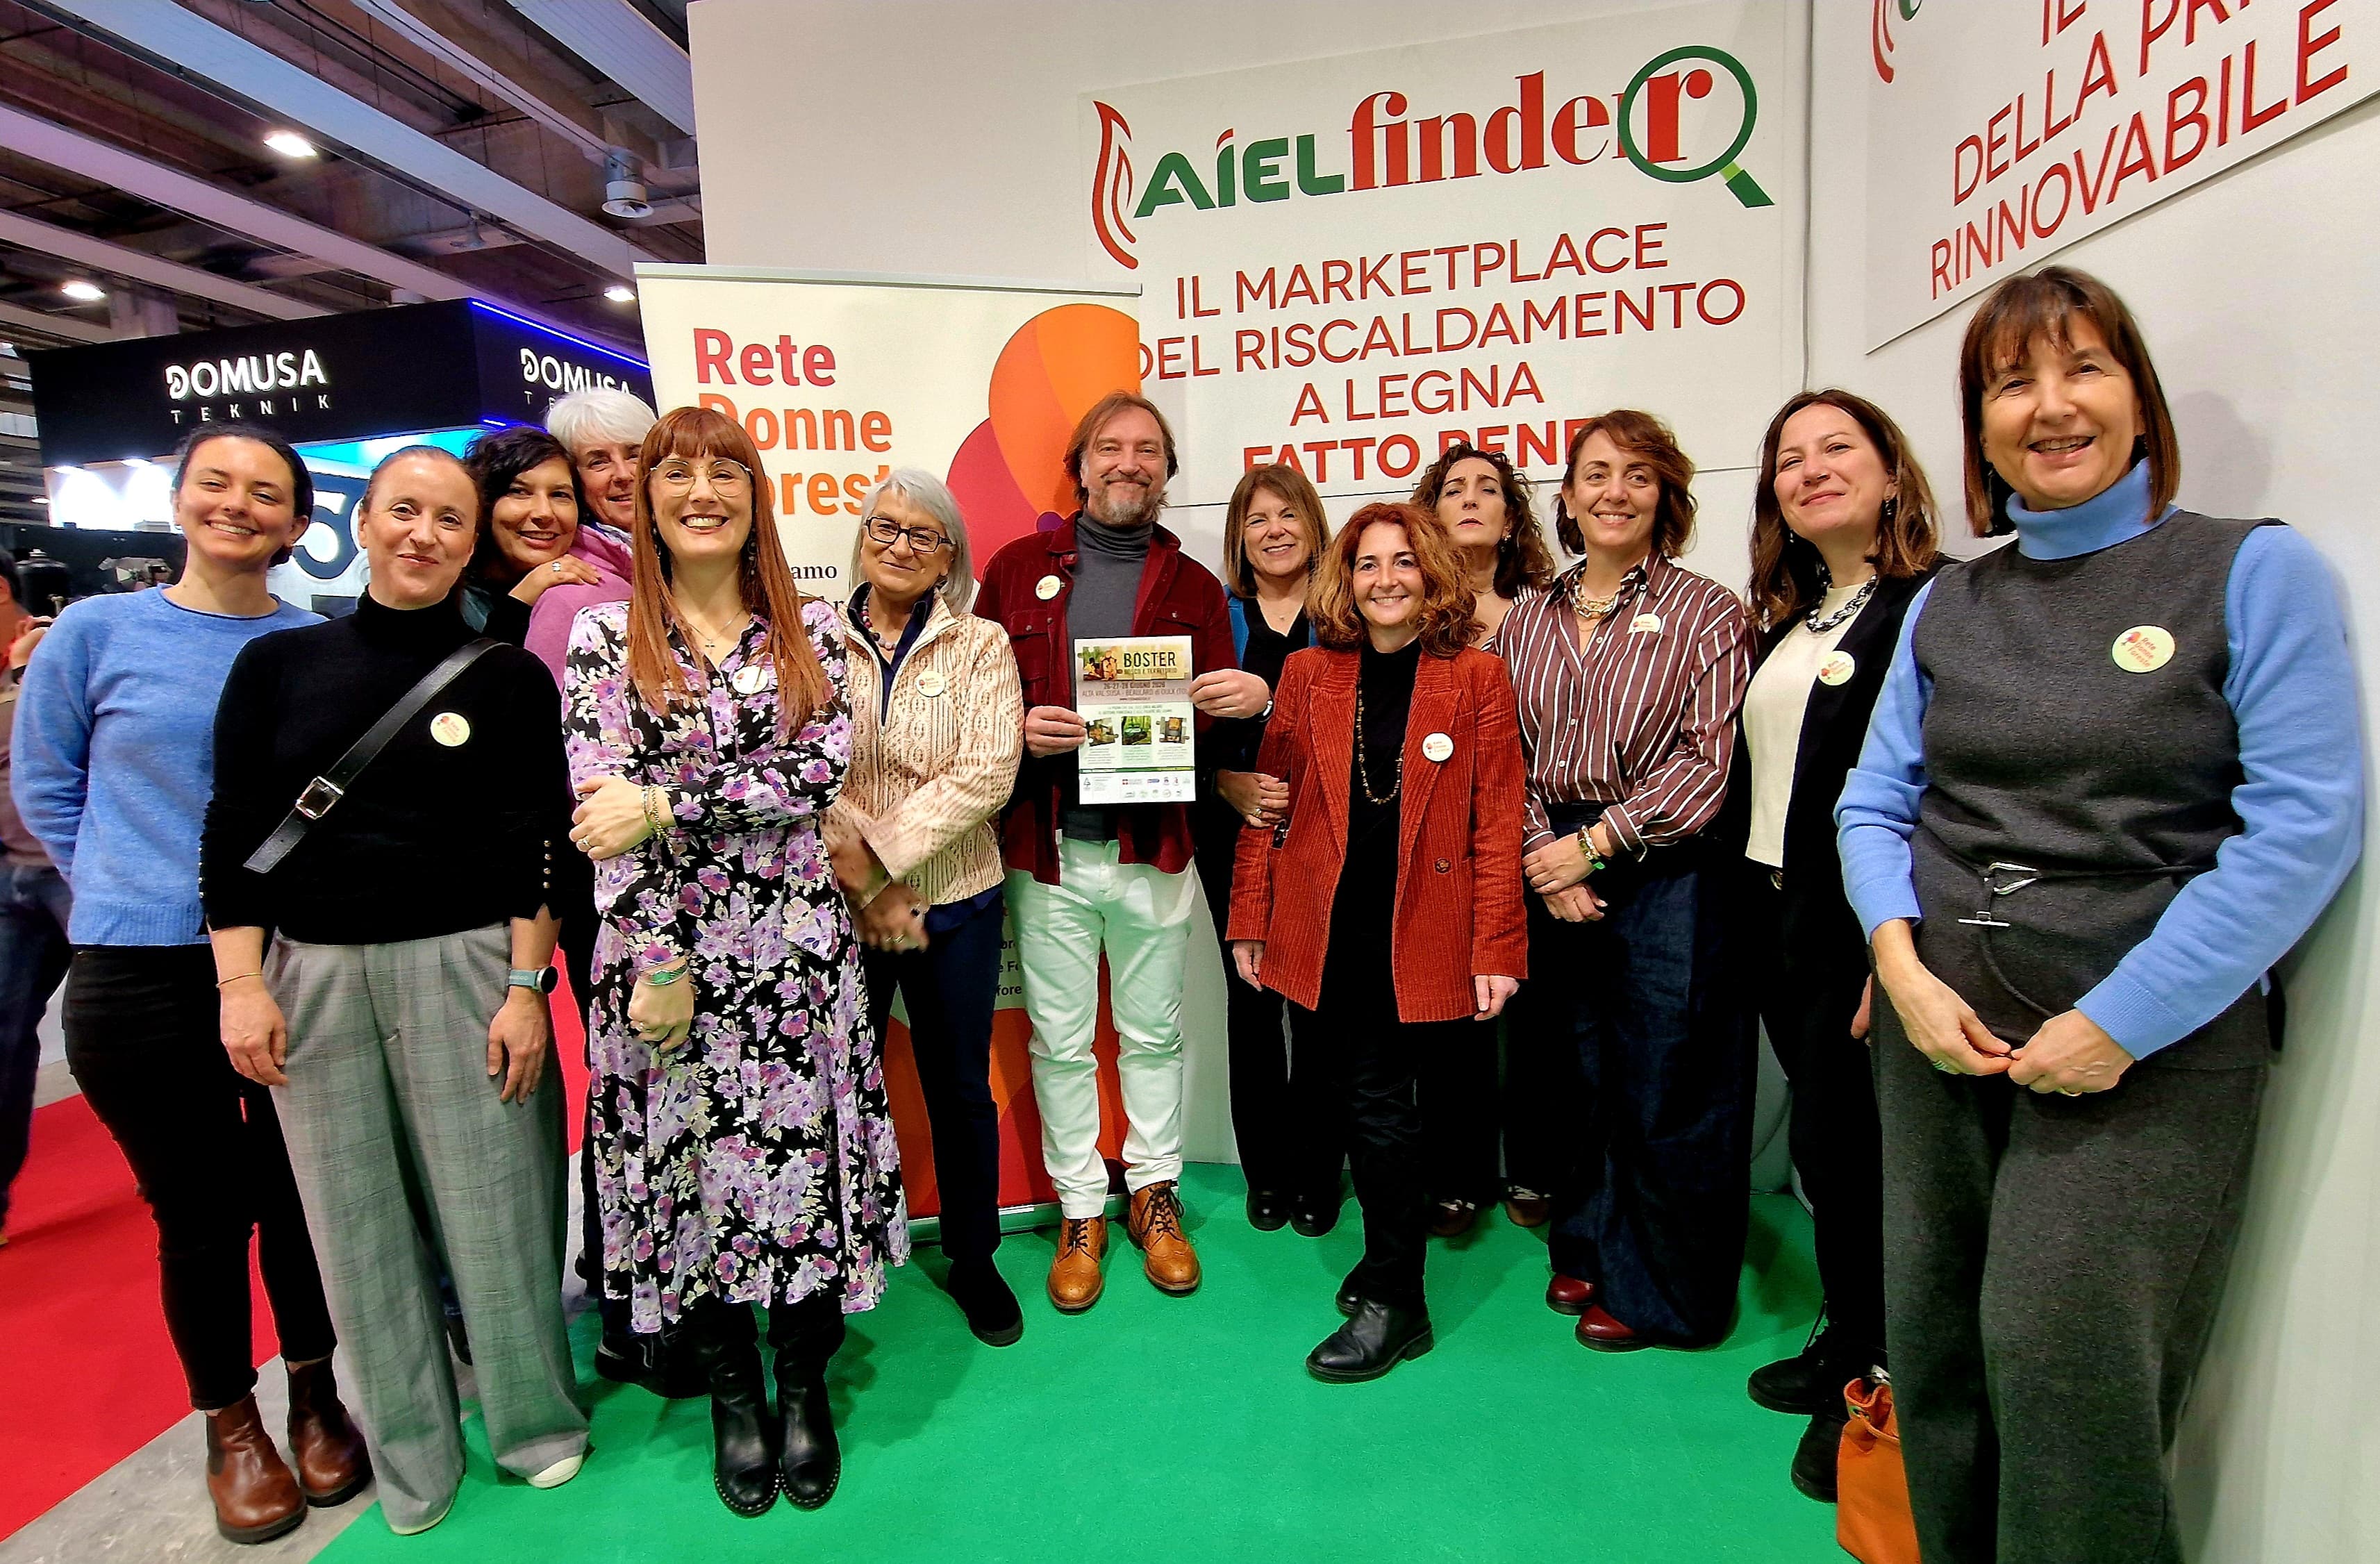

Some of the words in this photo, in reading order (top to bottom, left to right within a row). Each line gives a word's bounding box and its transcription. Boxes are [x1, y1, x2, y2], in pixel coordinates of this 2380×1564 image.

[1954, 31, 2117, 206] DELLA
[2140, 0, 2250, 76] PR
[1932, 0, 2348, 299] RINNOVABILE
[1177, 276, 1220, 319] IL
[1236, 223, 1668, 312] MARKETPLACE
[1235, 278, 1746, 372] RISCALDAMENTO
[165, 349, 328, 399] DOMUSA
[693, 328, 836, 387] Rete
[171, 394, 329, 424] TEKNIK
[1290, 383, 1330, 426] A
[1346, 362, 1545, 421] LEGNA
[1123, 651, 1176, 667] BOSTER
